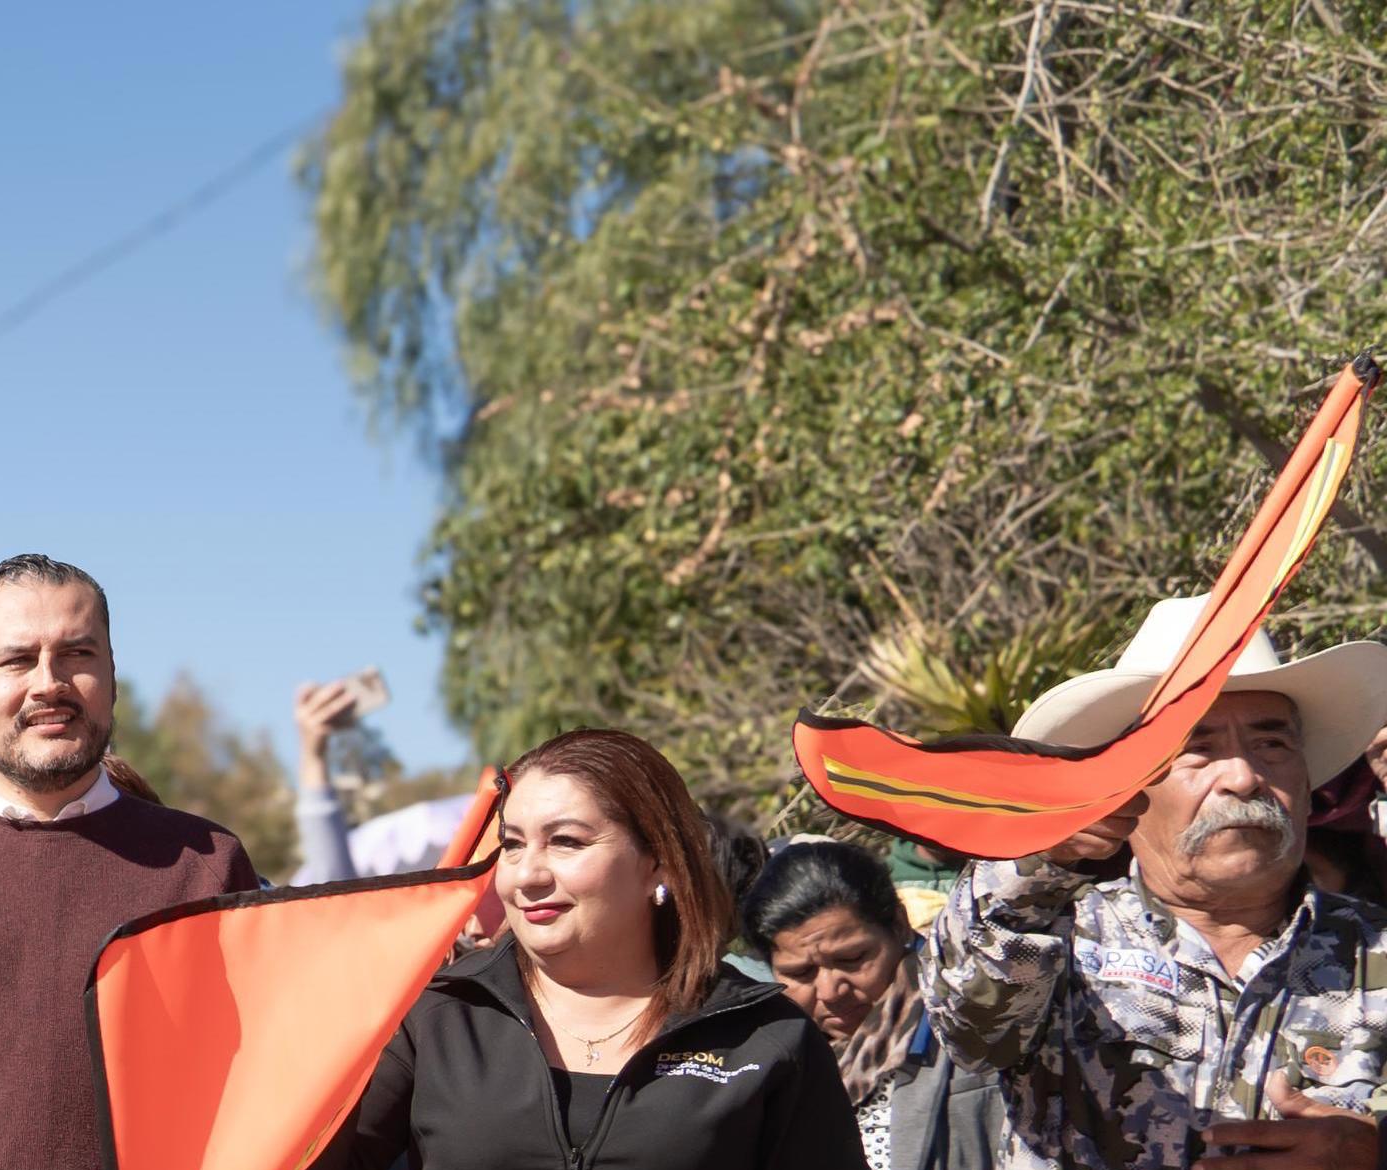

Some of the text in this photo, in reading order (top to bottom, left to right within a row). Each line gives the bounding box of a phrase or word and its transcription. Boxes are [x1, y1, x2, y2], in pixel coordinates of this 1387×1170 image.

[658, 1051, 724, 1067] DESOM
[701, 1063, 713, 1073] de
[685, 1069, 729, 1083] Municipal
